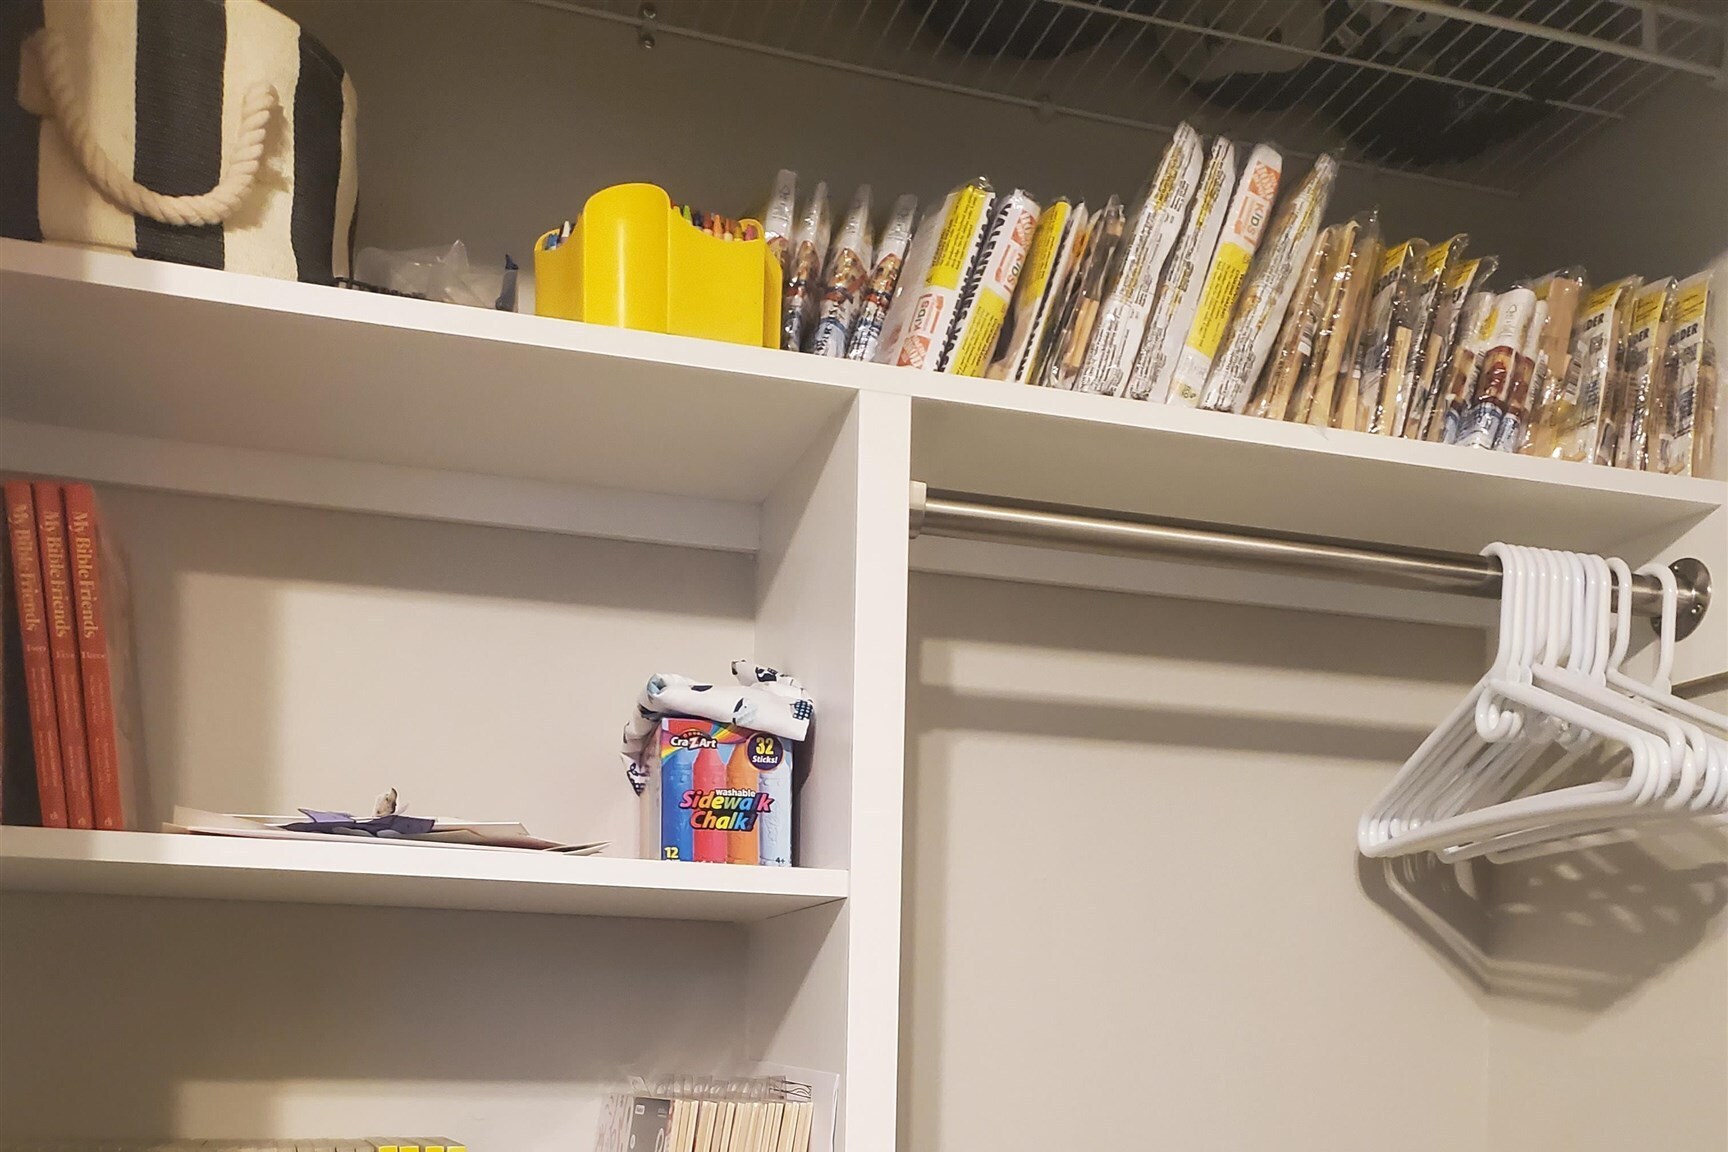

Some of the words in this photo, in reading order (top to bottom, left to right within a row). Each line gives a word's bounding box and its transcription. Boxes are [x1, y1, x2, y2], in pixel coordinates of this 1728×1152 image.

[69, 511, 88, 533] My
[75, 537, 93, 579] Bible
[40, 511, 60, 532] My
[51, 580, 71, 638] Friends
[79, 580, 99, 638] Friends
[755, 737, 774, 755] 32
[752, 755, 778, 764] Sticks!
[679, 790, 775, 812] Sidewalk
[715, 788, 756, 797] washable
[664, 846, 679, 859] 12
